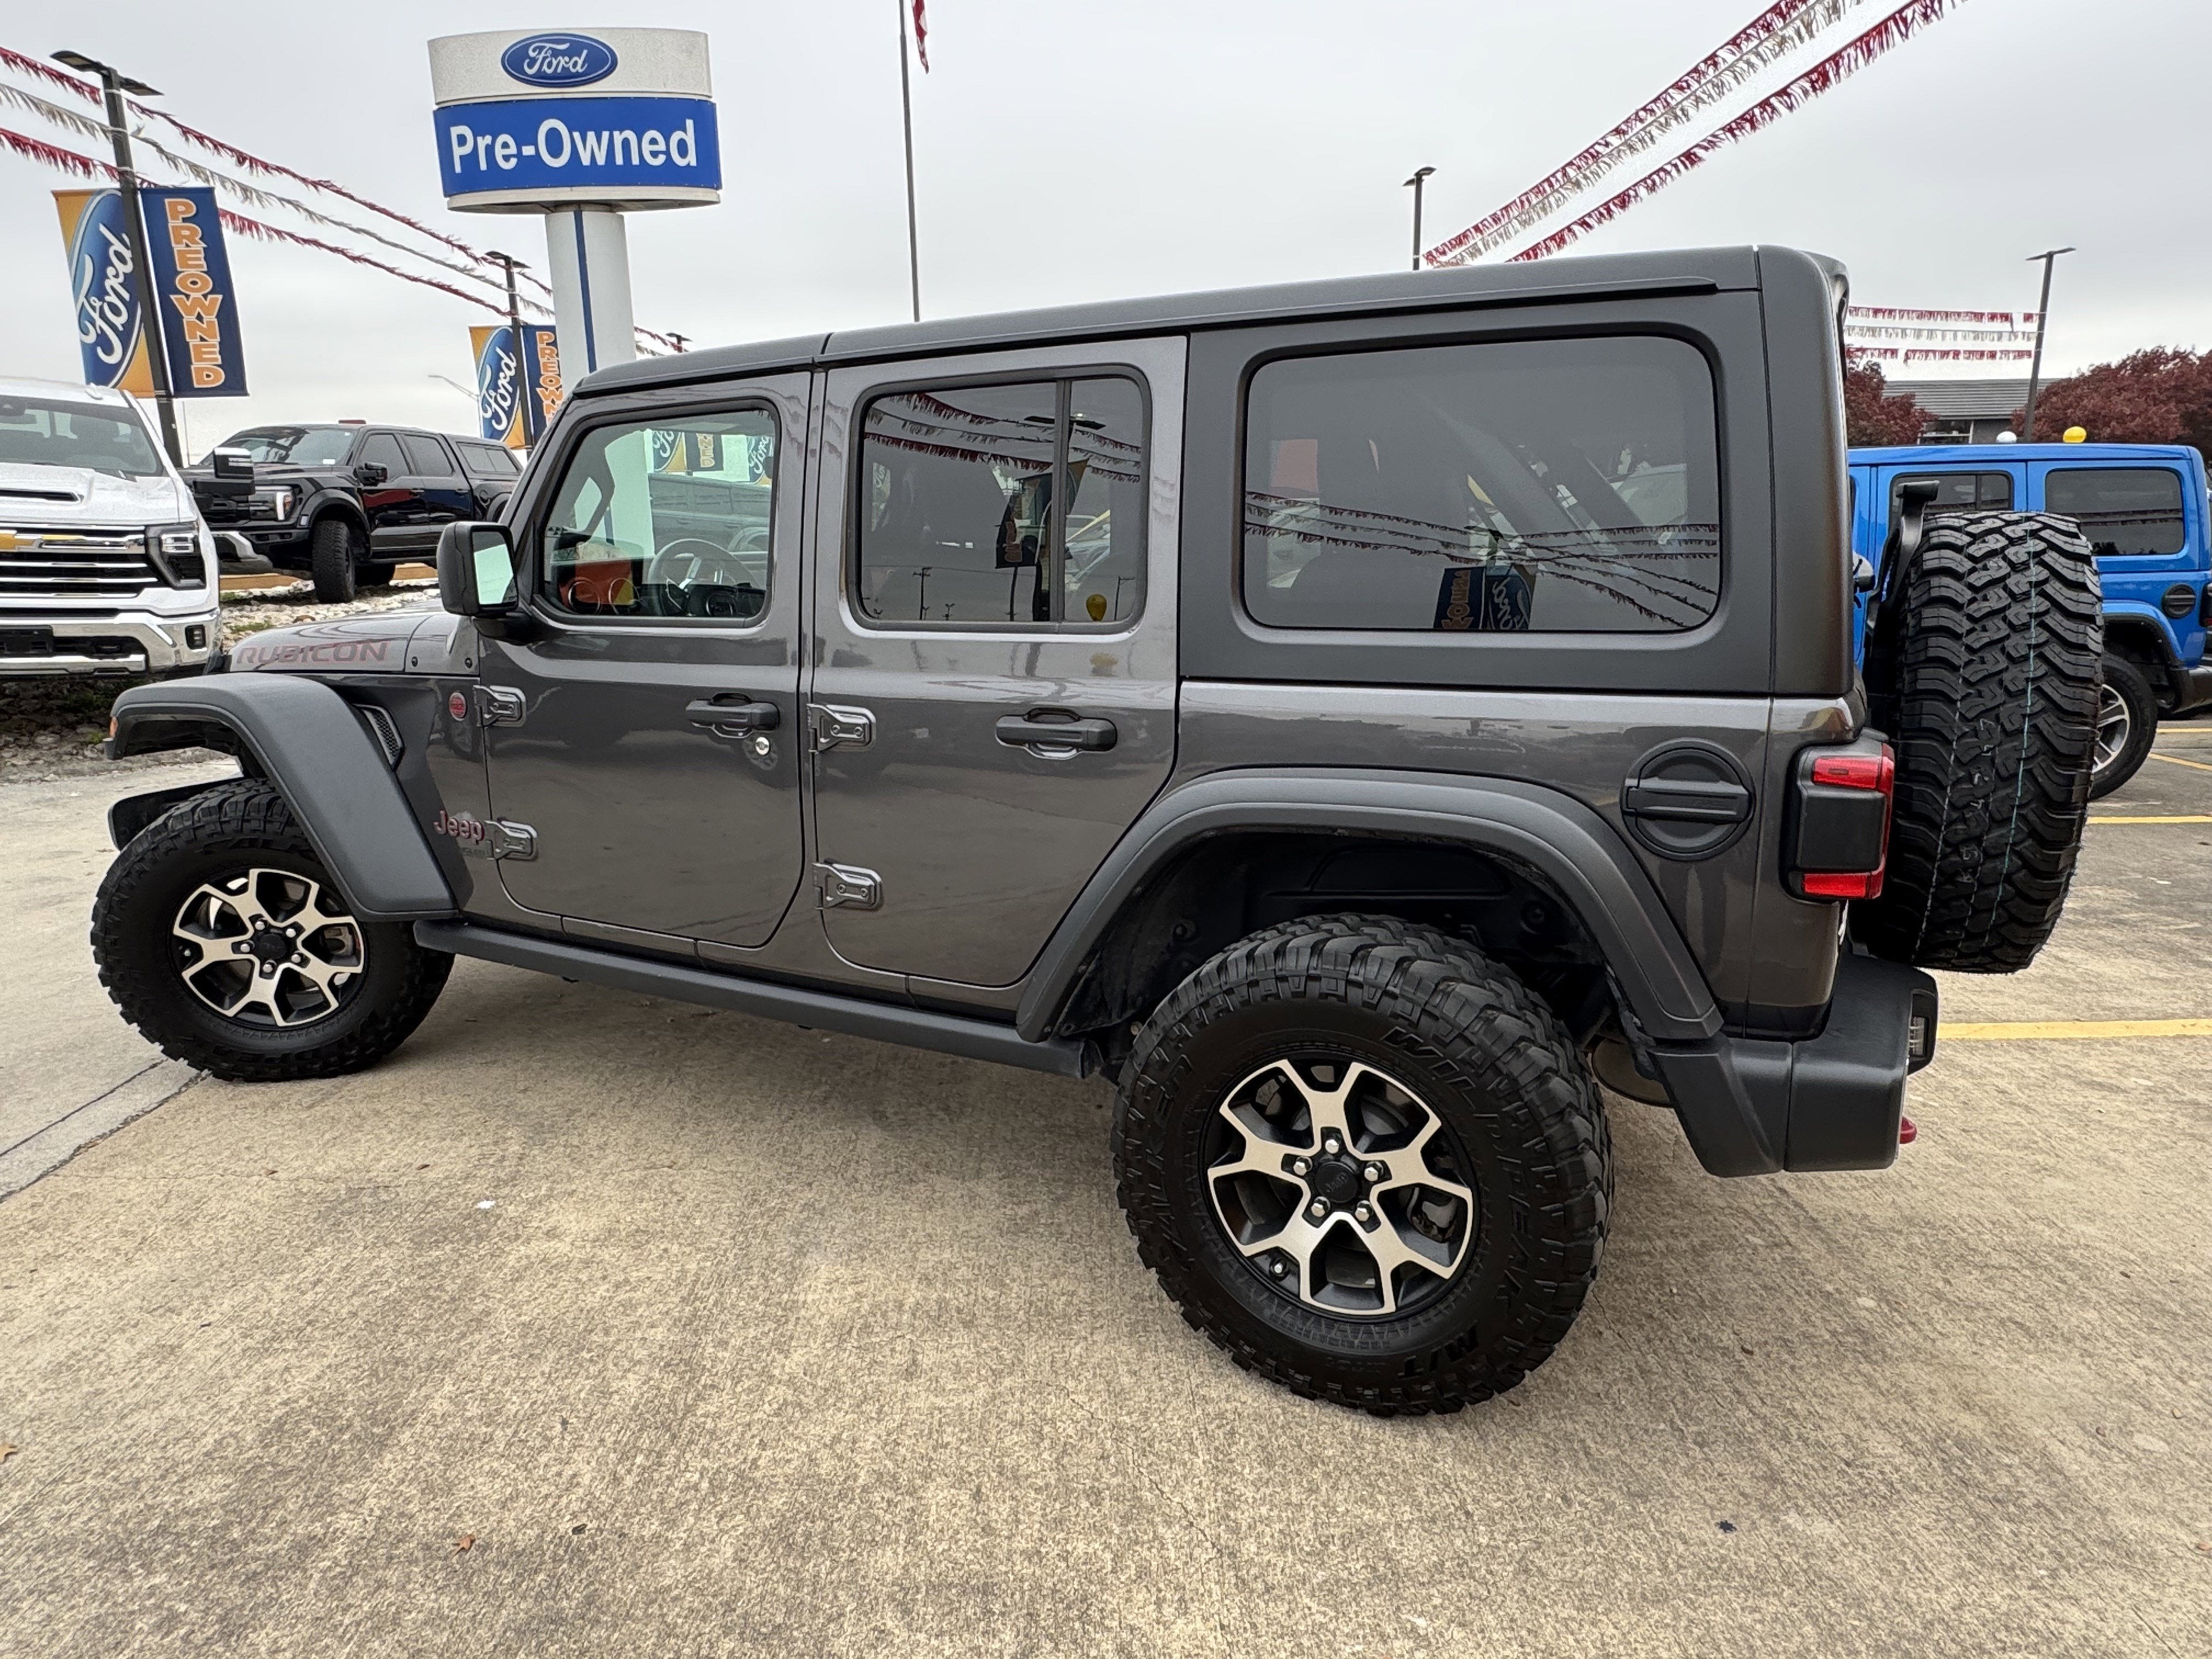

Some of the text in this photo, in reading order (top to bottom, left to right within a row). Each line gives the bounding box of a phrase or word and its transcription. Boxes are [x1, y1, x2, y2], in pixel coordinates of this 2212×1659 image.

[523, 42, 589, 75] Ford
[450, 119, 697, 173] Pre-Owned
[77, 223, 134, 364] Ford
[164, 198, 225, 388] PREOWNED
[481, 346, 517, 431] Ford
[535, 331, 564, 425] PREOWN
[236, 641, 391, 664] RUBICON
[433, 809, 485, 845] Jeep
